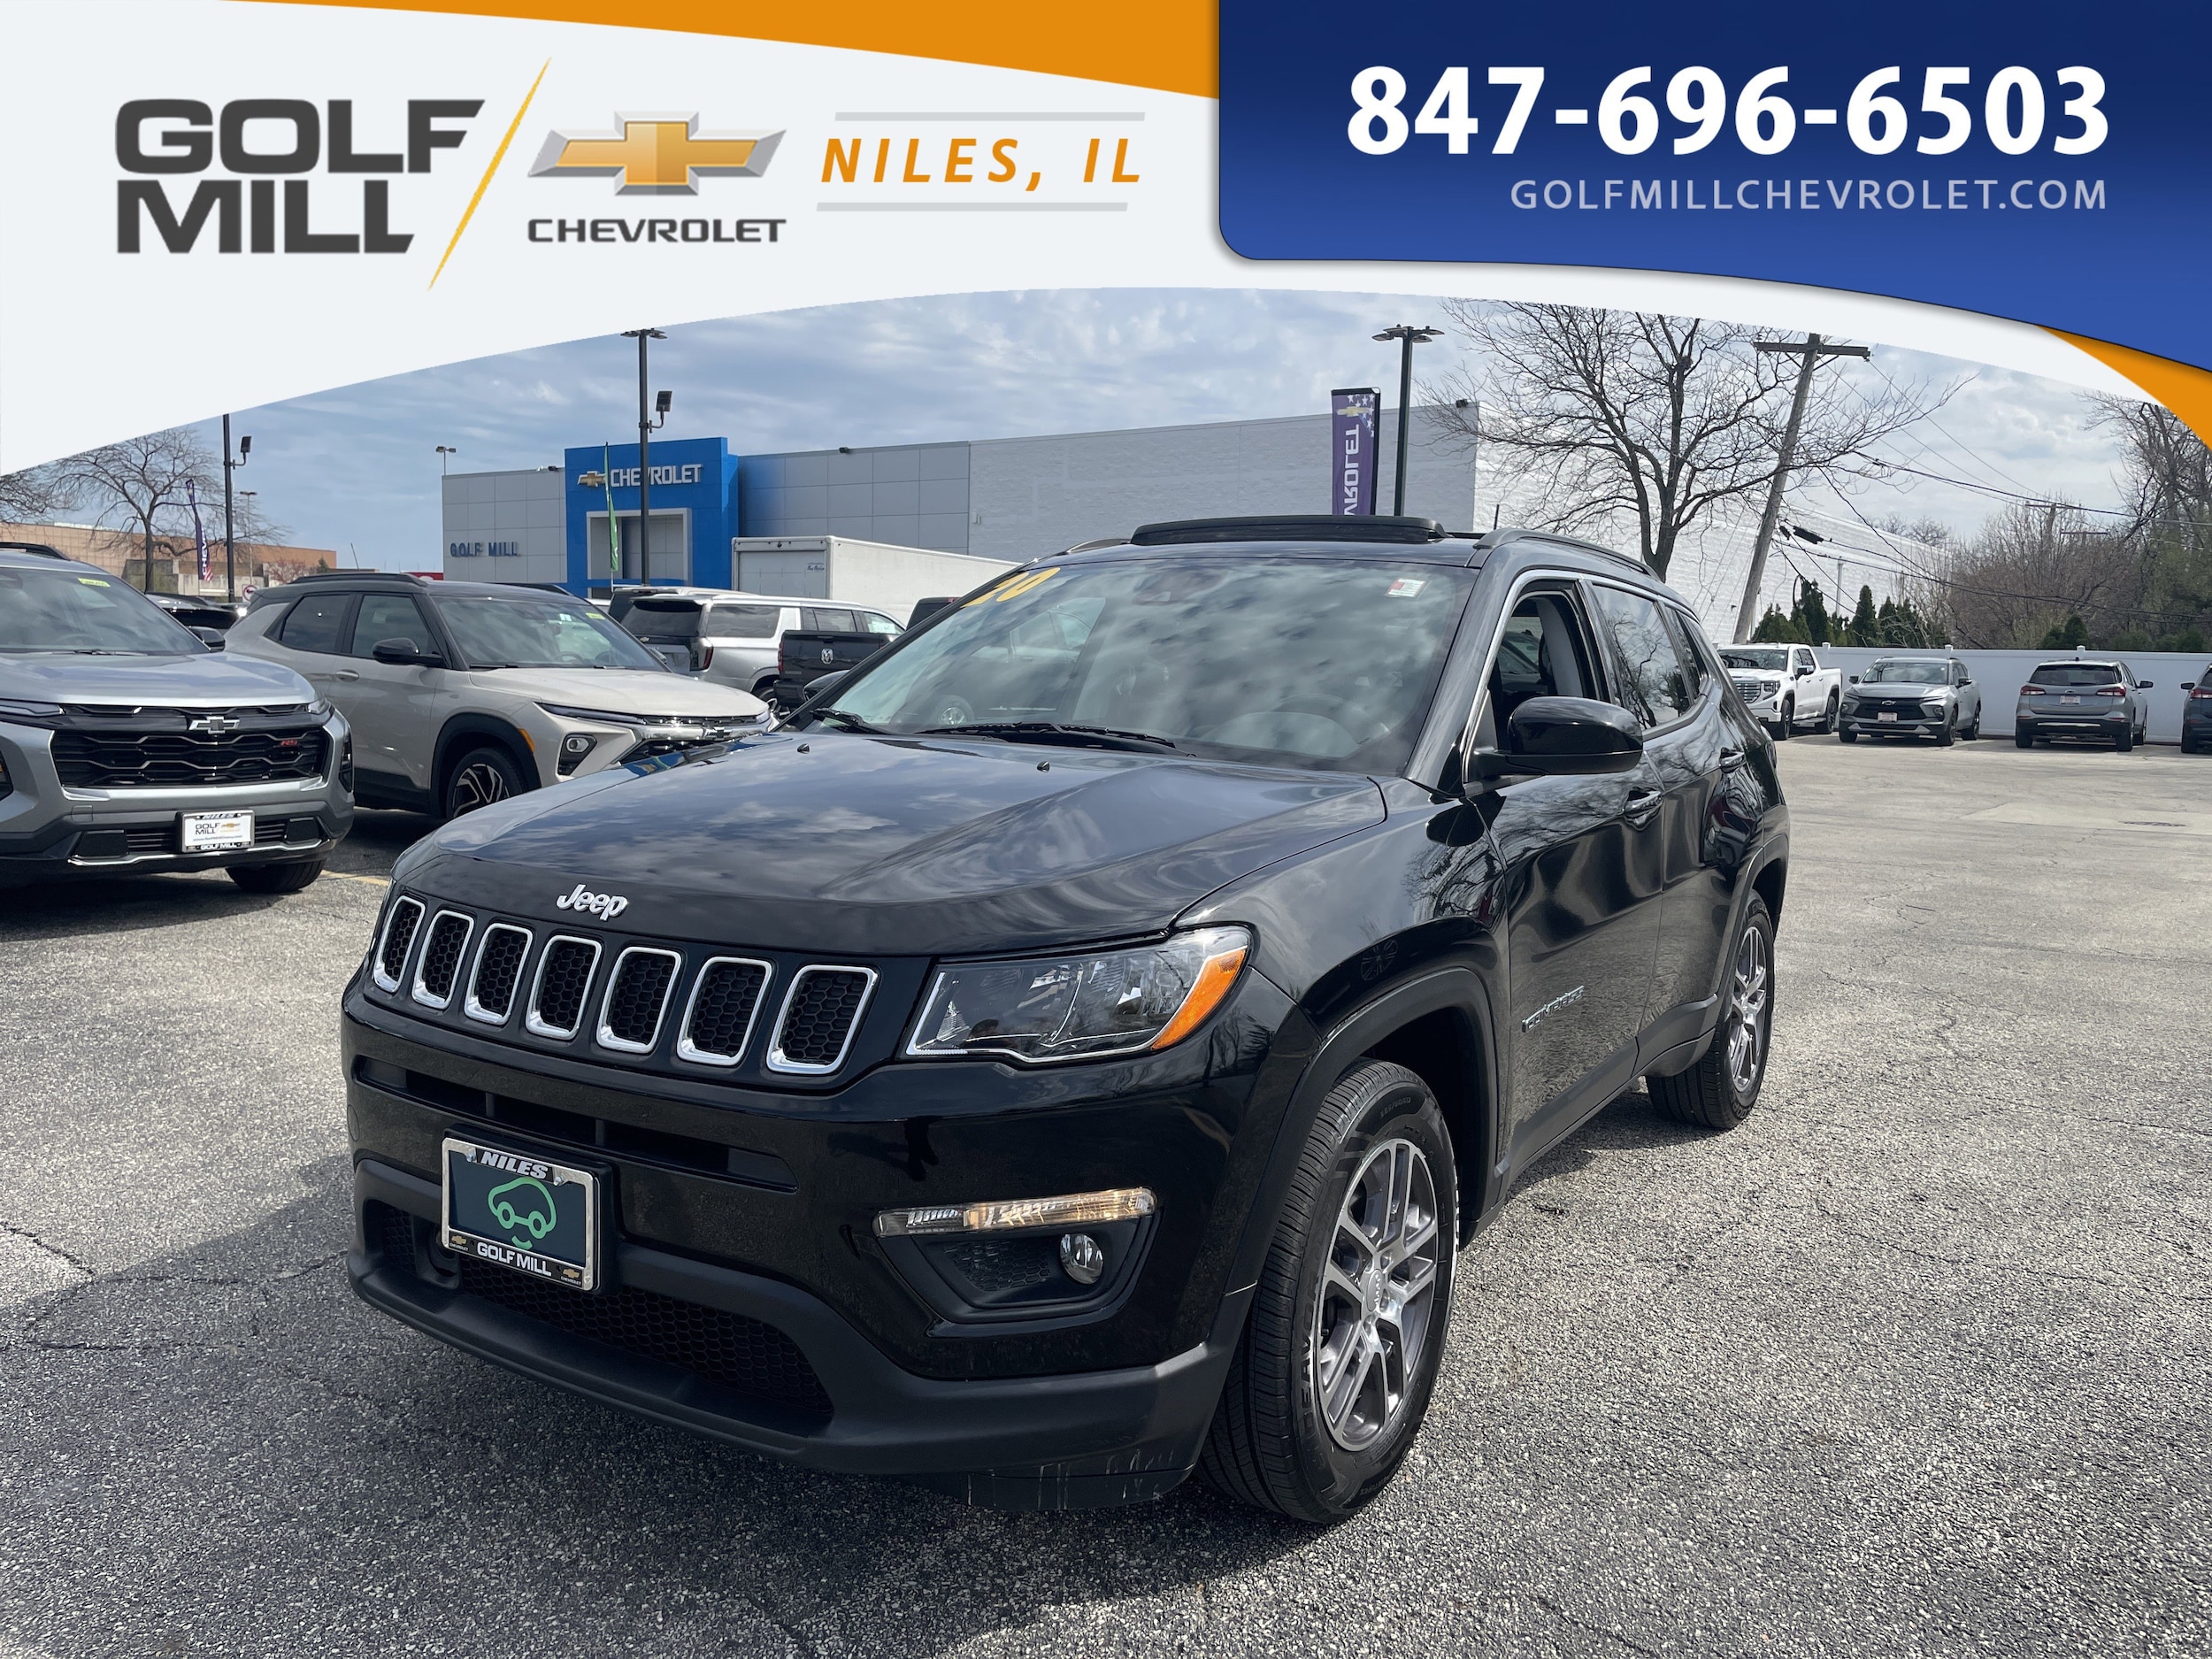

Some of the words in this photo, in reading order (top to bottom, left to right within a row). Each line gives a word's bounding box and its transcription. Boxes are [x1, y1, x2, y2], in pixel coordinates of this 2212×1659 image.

[611, 464, 702, 488] CHEROLET
[450, 541, 483, 557] GOLF
[488, 541, 518, 557] MILL
[557, 884, 628, 921] Jeep
[480, 1150, 549, 1179] NILES
[477, 1241, 516, 1264] GOLF
[516, 1254, 552, 1277] MILL
